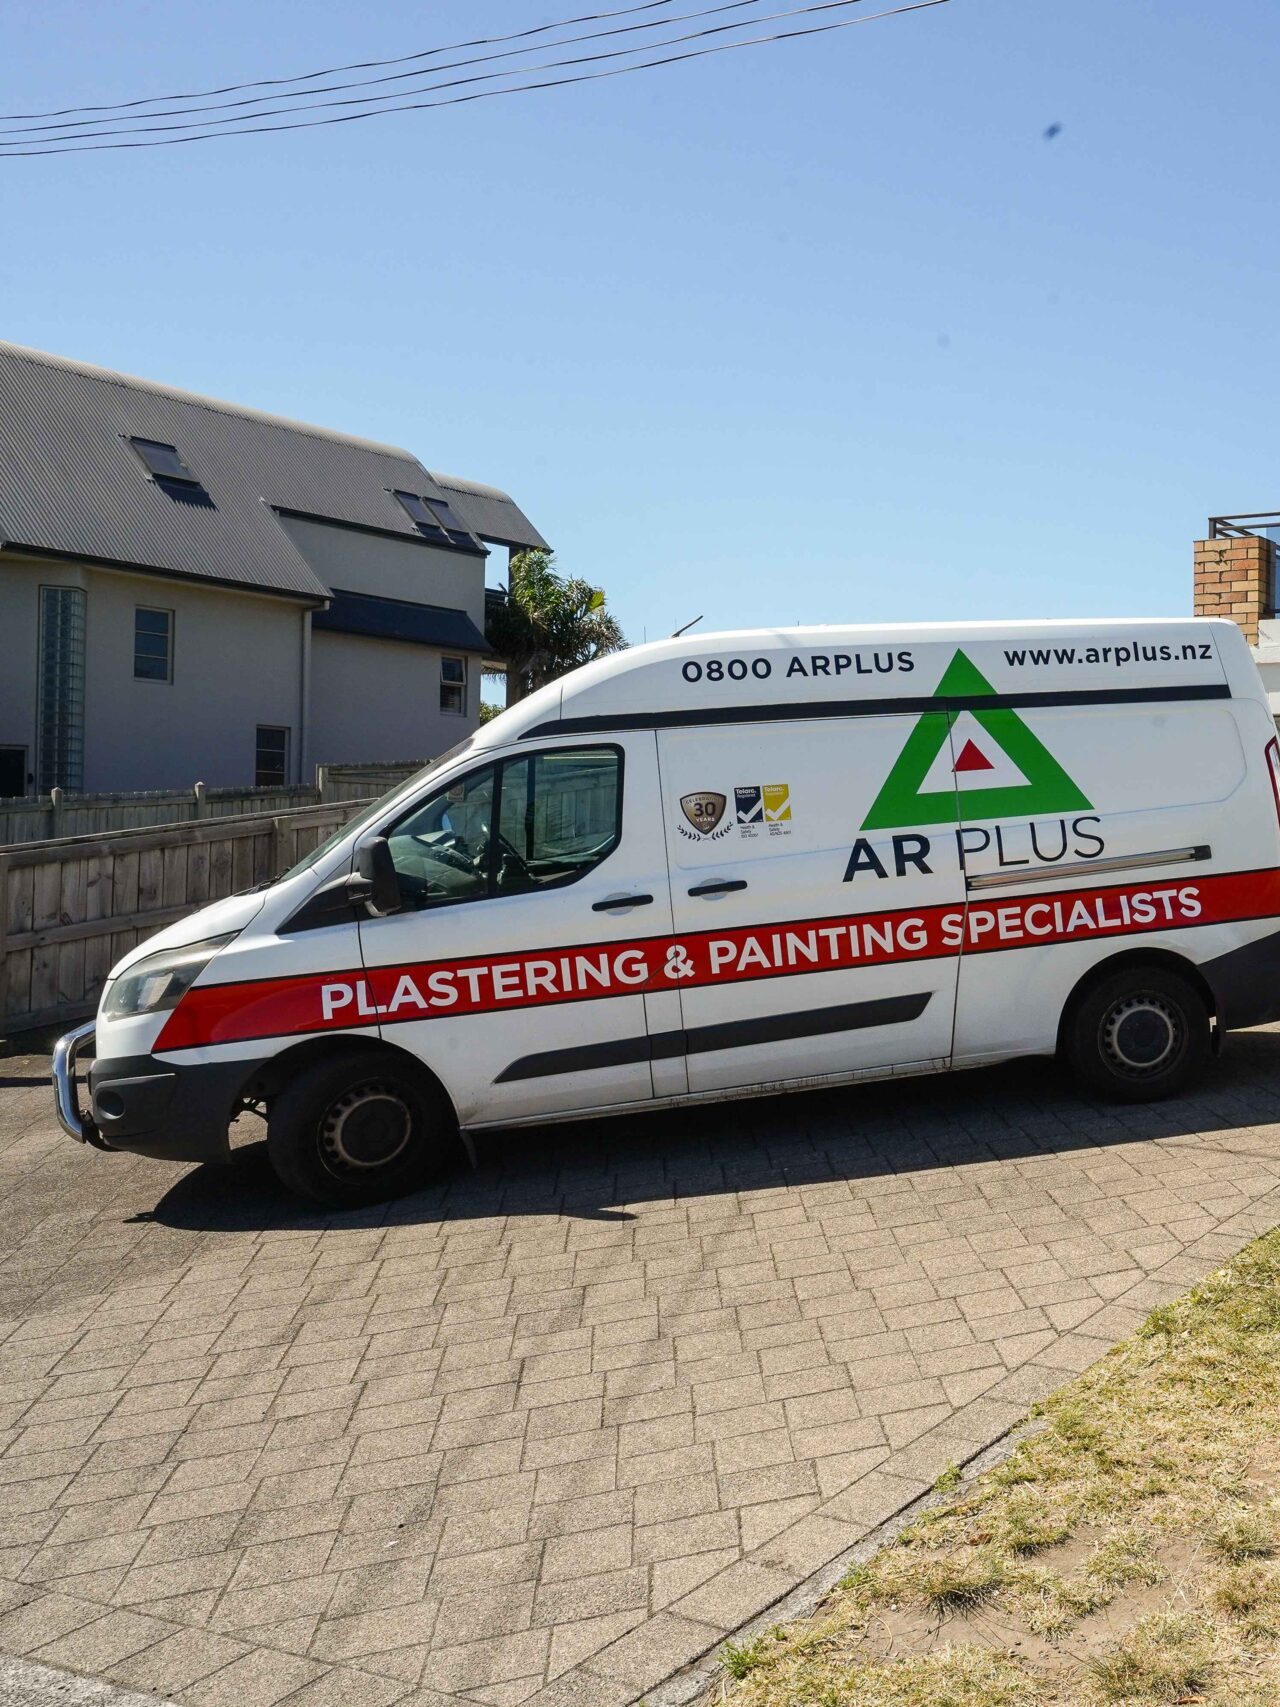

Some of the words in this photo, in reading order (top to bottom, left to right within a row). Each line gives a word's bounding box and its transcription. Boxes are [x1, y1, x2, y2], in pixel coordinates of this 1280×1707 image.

[681, 657, 772, 683] 0800
[785, 651, 915, 678] ARPLUS
[1003, 641, 1213, 667] www.arplus.nz
[694, 802, 716, 817] 30
[842, 833, 935, 883] AR
[955, 816, 1105, 871] PLUS
[320, 947, 650, 1021] PLASTERING
[663, 945, 696, 980] &
[708, 917, 928, 975] PAINTING
[940, 885, 1203, 947] SPECIALISTS
